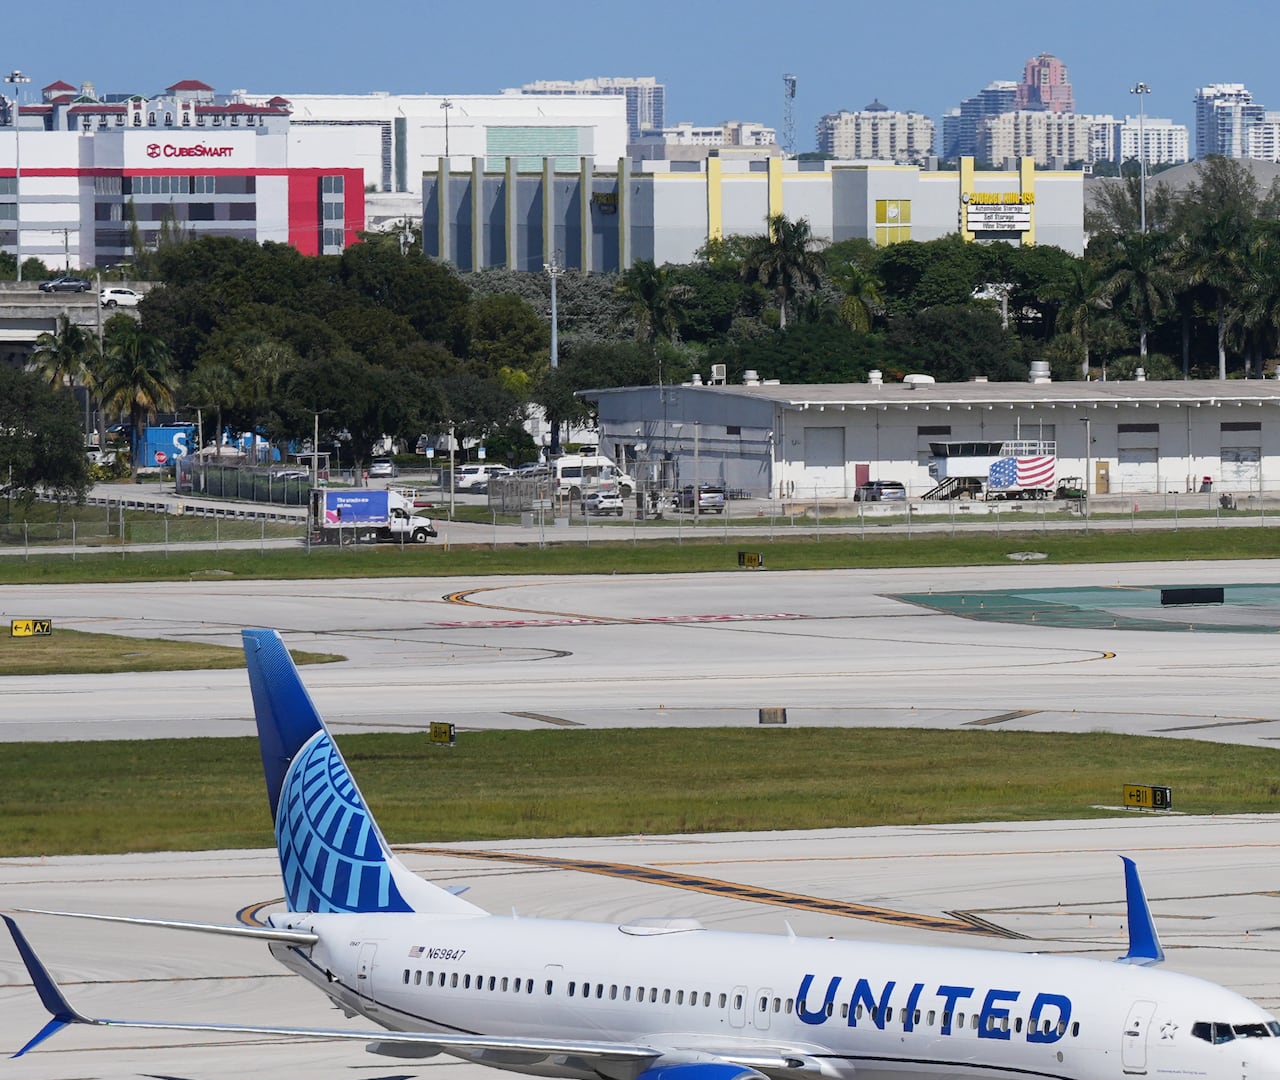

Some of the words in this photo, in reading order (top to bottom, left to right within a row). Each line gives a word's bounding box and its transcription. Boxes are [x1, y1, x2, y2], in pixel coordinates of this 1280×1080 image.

[1022, 192, 1035, 204] USA
[1004, 205, 1023, 213] Storage
[996, 222, 1015, 230] Storage
[24, 624, 31, 632] A
[34, 623, 50, 633] A7
[1136, 789, 1147, 800] B11
[428, 948, 466, 961] N69847
[795, 974, 1072, 1044] UNITED
